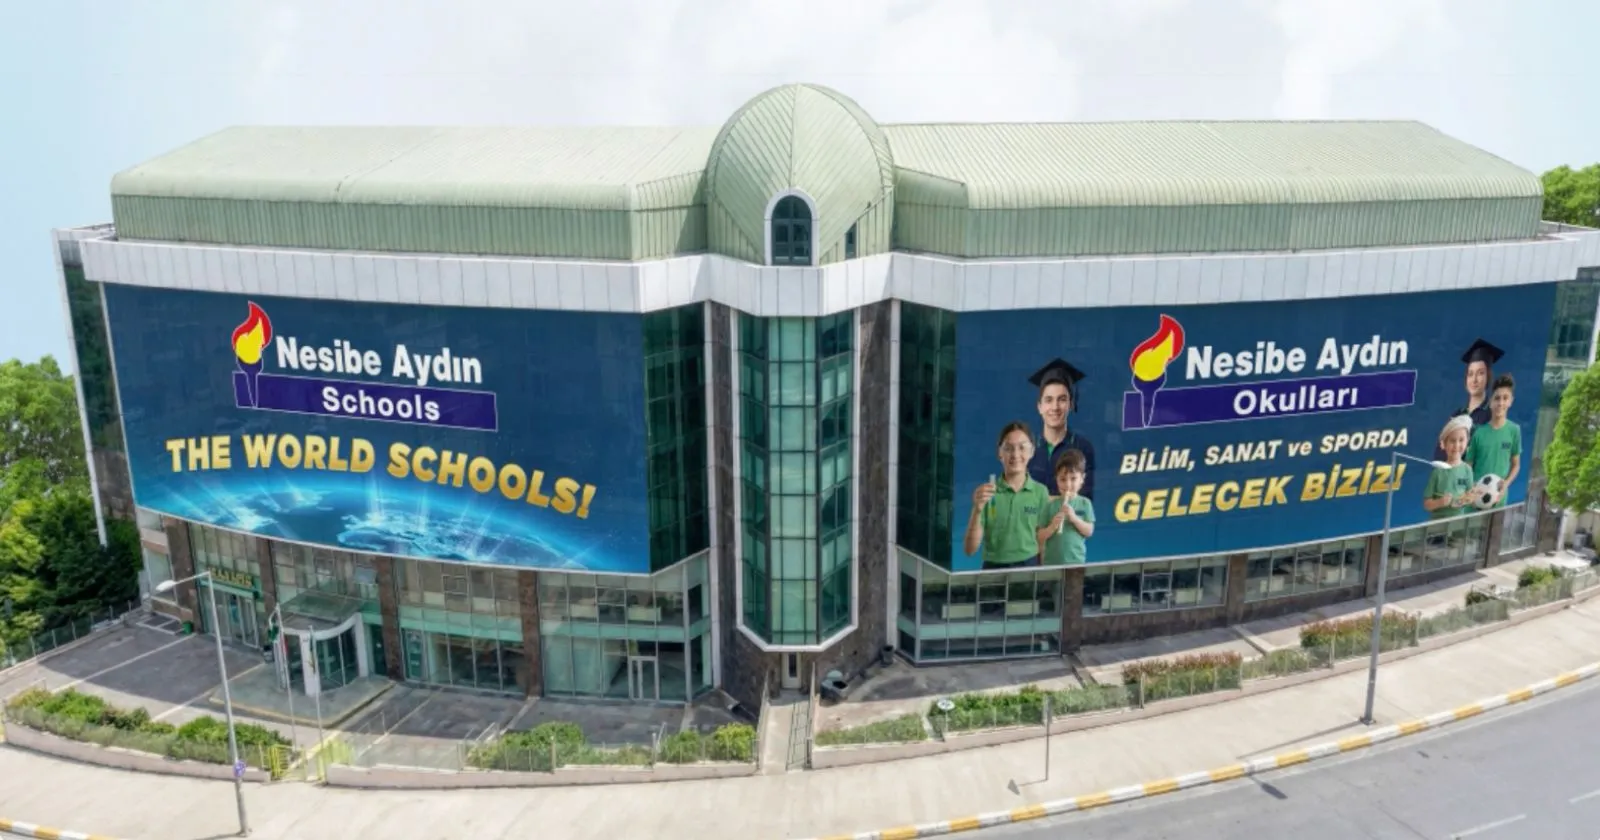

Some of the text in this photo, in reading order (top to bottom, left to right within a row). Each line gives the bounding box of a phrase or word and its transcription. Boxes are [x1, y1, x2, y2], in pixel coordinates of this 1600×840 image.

[276, 336, 482, 387] Nesibe Aydın
[1185, 334, 1408, 380] Nesibe Aydın
[322, 386, 440, 421] Schools
[1233, 385, 1358, 416] Okulları
[1119, 428, 1408, 475] BİLİM, SANAT ve SPORDA
[166, 433, 597, 519] THE WORLD SCHOOLS!
[1114, 460, 1407, 523] GELECEK BİZİZ!
